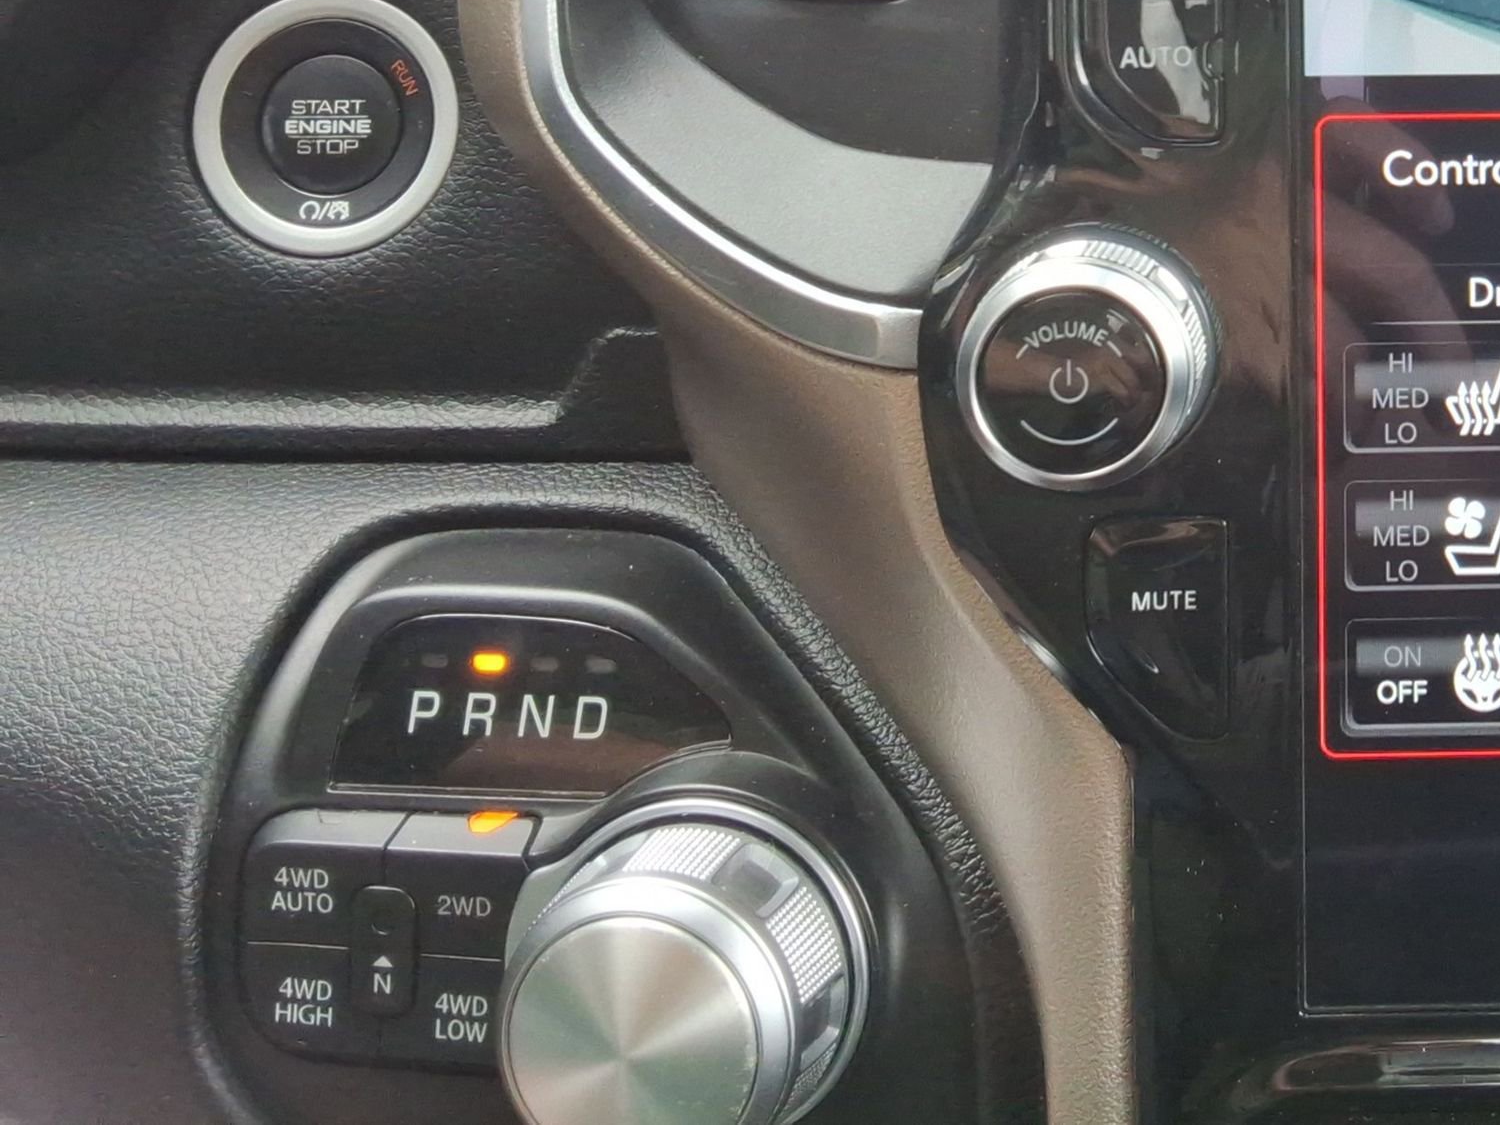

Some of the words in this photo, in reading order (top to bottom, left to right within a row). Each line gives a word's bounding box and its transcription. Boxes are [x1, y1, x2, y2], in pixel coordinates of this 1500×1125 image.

[1119, 46, 1193, 69] AUTO
[390, 58, 419, 97] RUN
[291, 99, 367, 114] START
[284, 119, 372, 134] ENGINE
[296, 139, 359, 155] STOP
[1023, 321, 1109, 350] VOLUME
[1388, 353, 1413, 373] HI
[1371, 388, 1429, 409] MED
[1384, 423, 1418, 444] LO
[1389, 490, 1414, 511] HI
[1372, 525, 1430, 547] MED
[1385, 560, 1418, 582] LO
[1130, 590, 1197, 612] MUTE
[1383, 646, 1422, 668] ON
[1376, 679, 1428, 705] OFF
[406, 690, 440, 734] P
[462, 692, 496, 736] R
[518, 694, 556, 738] N
[572, 695, 608, 740] D
[274, 866, 329, 889] 4WD
[270, 891, 334, 914] AUTO
[436, 895, 492, 918] 2WD
[279, 977, 332, 1000] 4WD
[373, 973, 392, 995] N
[274, 1003, 333, 1028] HIGH
[434, 993, 488, 1017] 4WD
[434, 1019, 488, 1043] LOW
